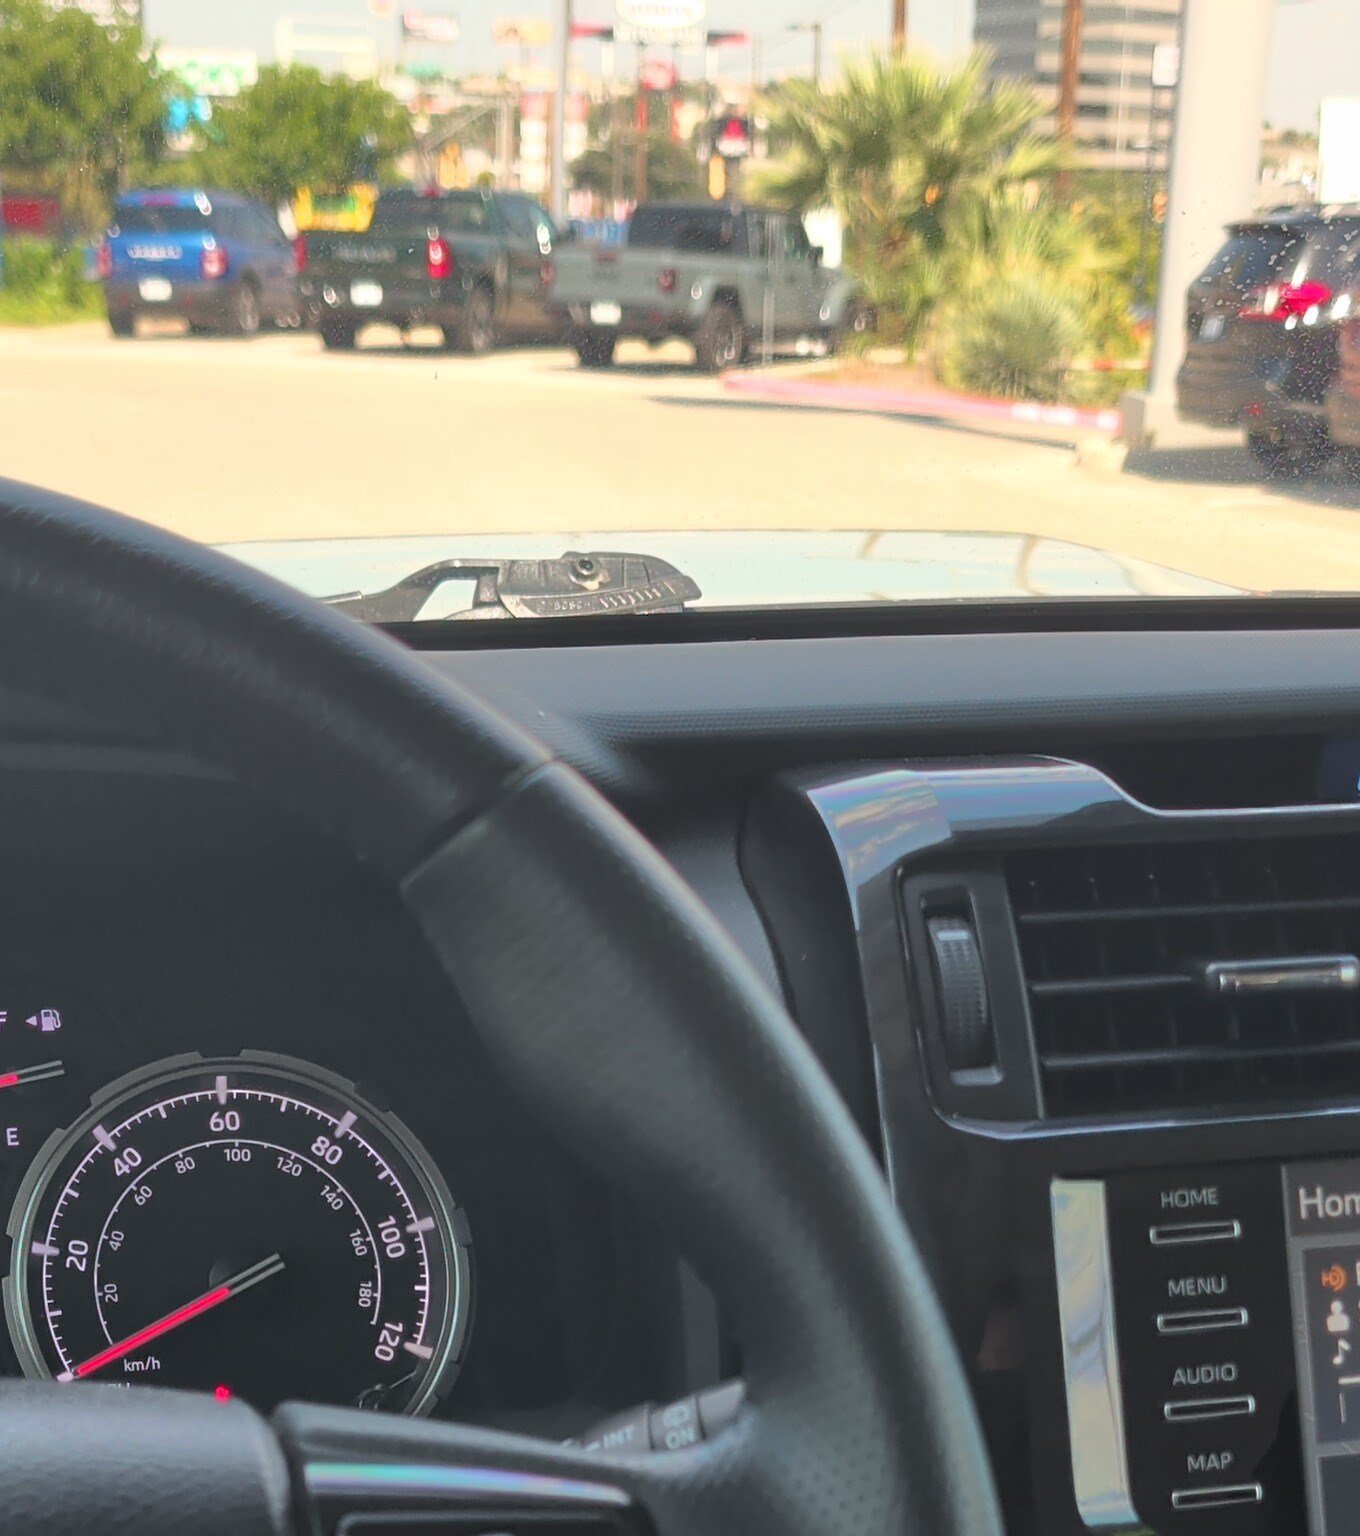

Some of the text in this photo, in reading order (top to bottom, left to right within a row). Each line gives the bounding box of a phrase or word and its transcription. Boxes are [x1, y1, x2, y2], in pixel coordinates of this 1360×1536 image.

[209, 1110, 241, 1132] 60
[6, 1127, 19, 1146] E
[112, 1146, 143, 1178] 40
[223, 1147, 252, 1163] 100
[310, 1135, 343, 1167] 80
[174, 1156, 196, 1175] 80
[275, 1156, 304, 1178] 120
[134, 1184, 154, 1207] 60
[320, 1184, 345, 1212] 140
[1161, 1187, 1219, 1209] HOME
[108, 1230, 125, 1252] 40
[348, 1228, 368, 1257] 160
[377, 1215, 406, 1260] 100
[65, 1239, 89, 1272] 20
[104, 1282, 119, 1304] 20
[358, 1280, 372, 1308] 180
[1168, 1276, 1227, 1298] MENU
[374, 1320, 404, 1362] 120
[123, 1356, 161, 1372] km/h
[1172, 1363, 1238, 1385] AUDIO
[664, 1425, 696, 1450] ON
[1187, 1452, 1234, 1473] MAP
